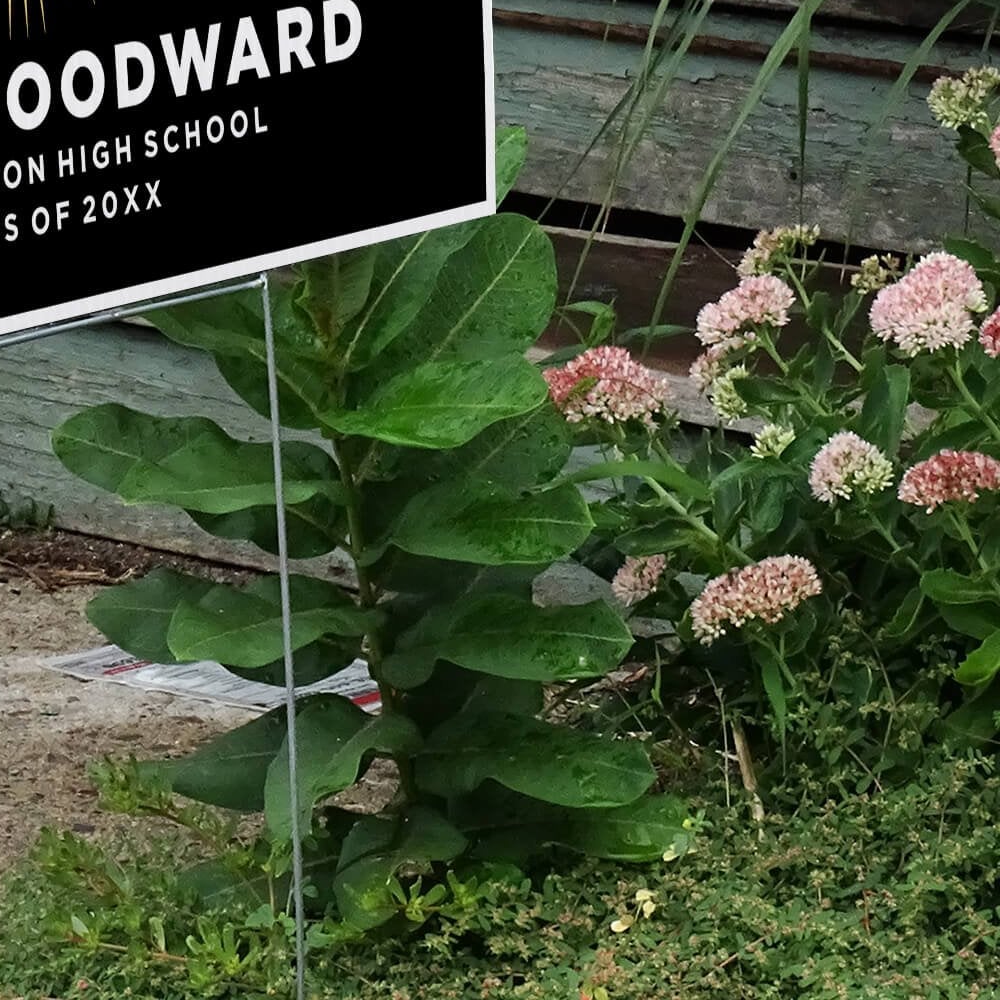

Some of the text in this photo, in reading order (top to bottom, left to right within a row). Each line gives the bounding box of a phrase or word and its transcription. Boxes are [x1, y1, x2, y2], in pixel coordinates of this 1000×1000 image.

[57, 134, 132, 178] HIGH
[144, 106, 268, 158] SCHOOL
[31, 200, 70, 236] OF
[82, 179, 162, 225] 20XX
